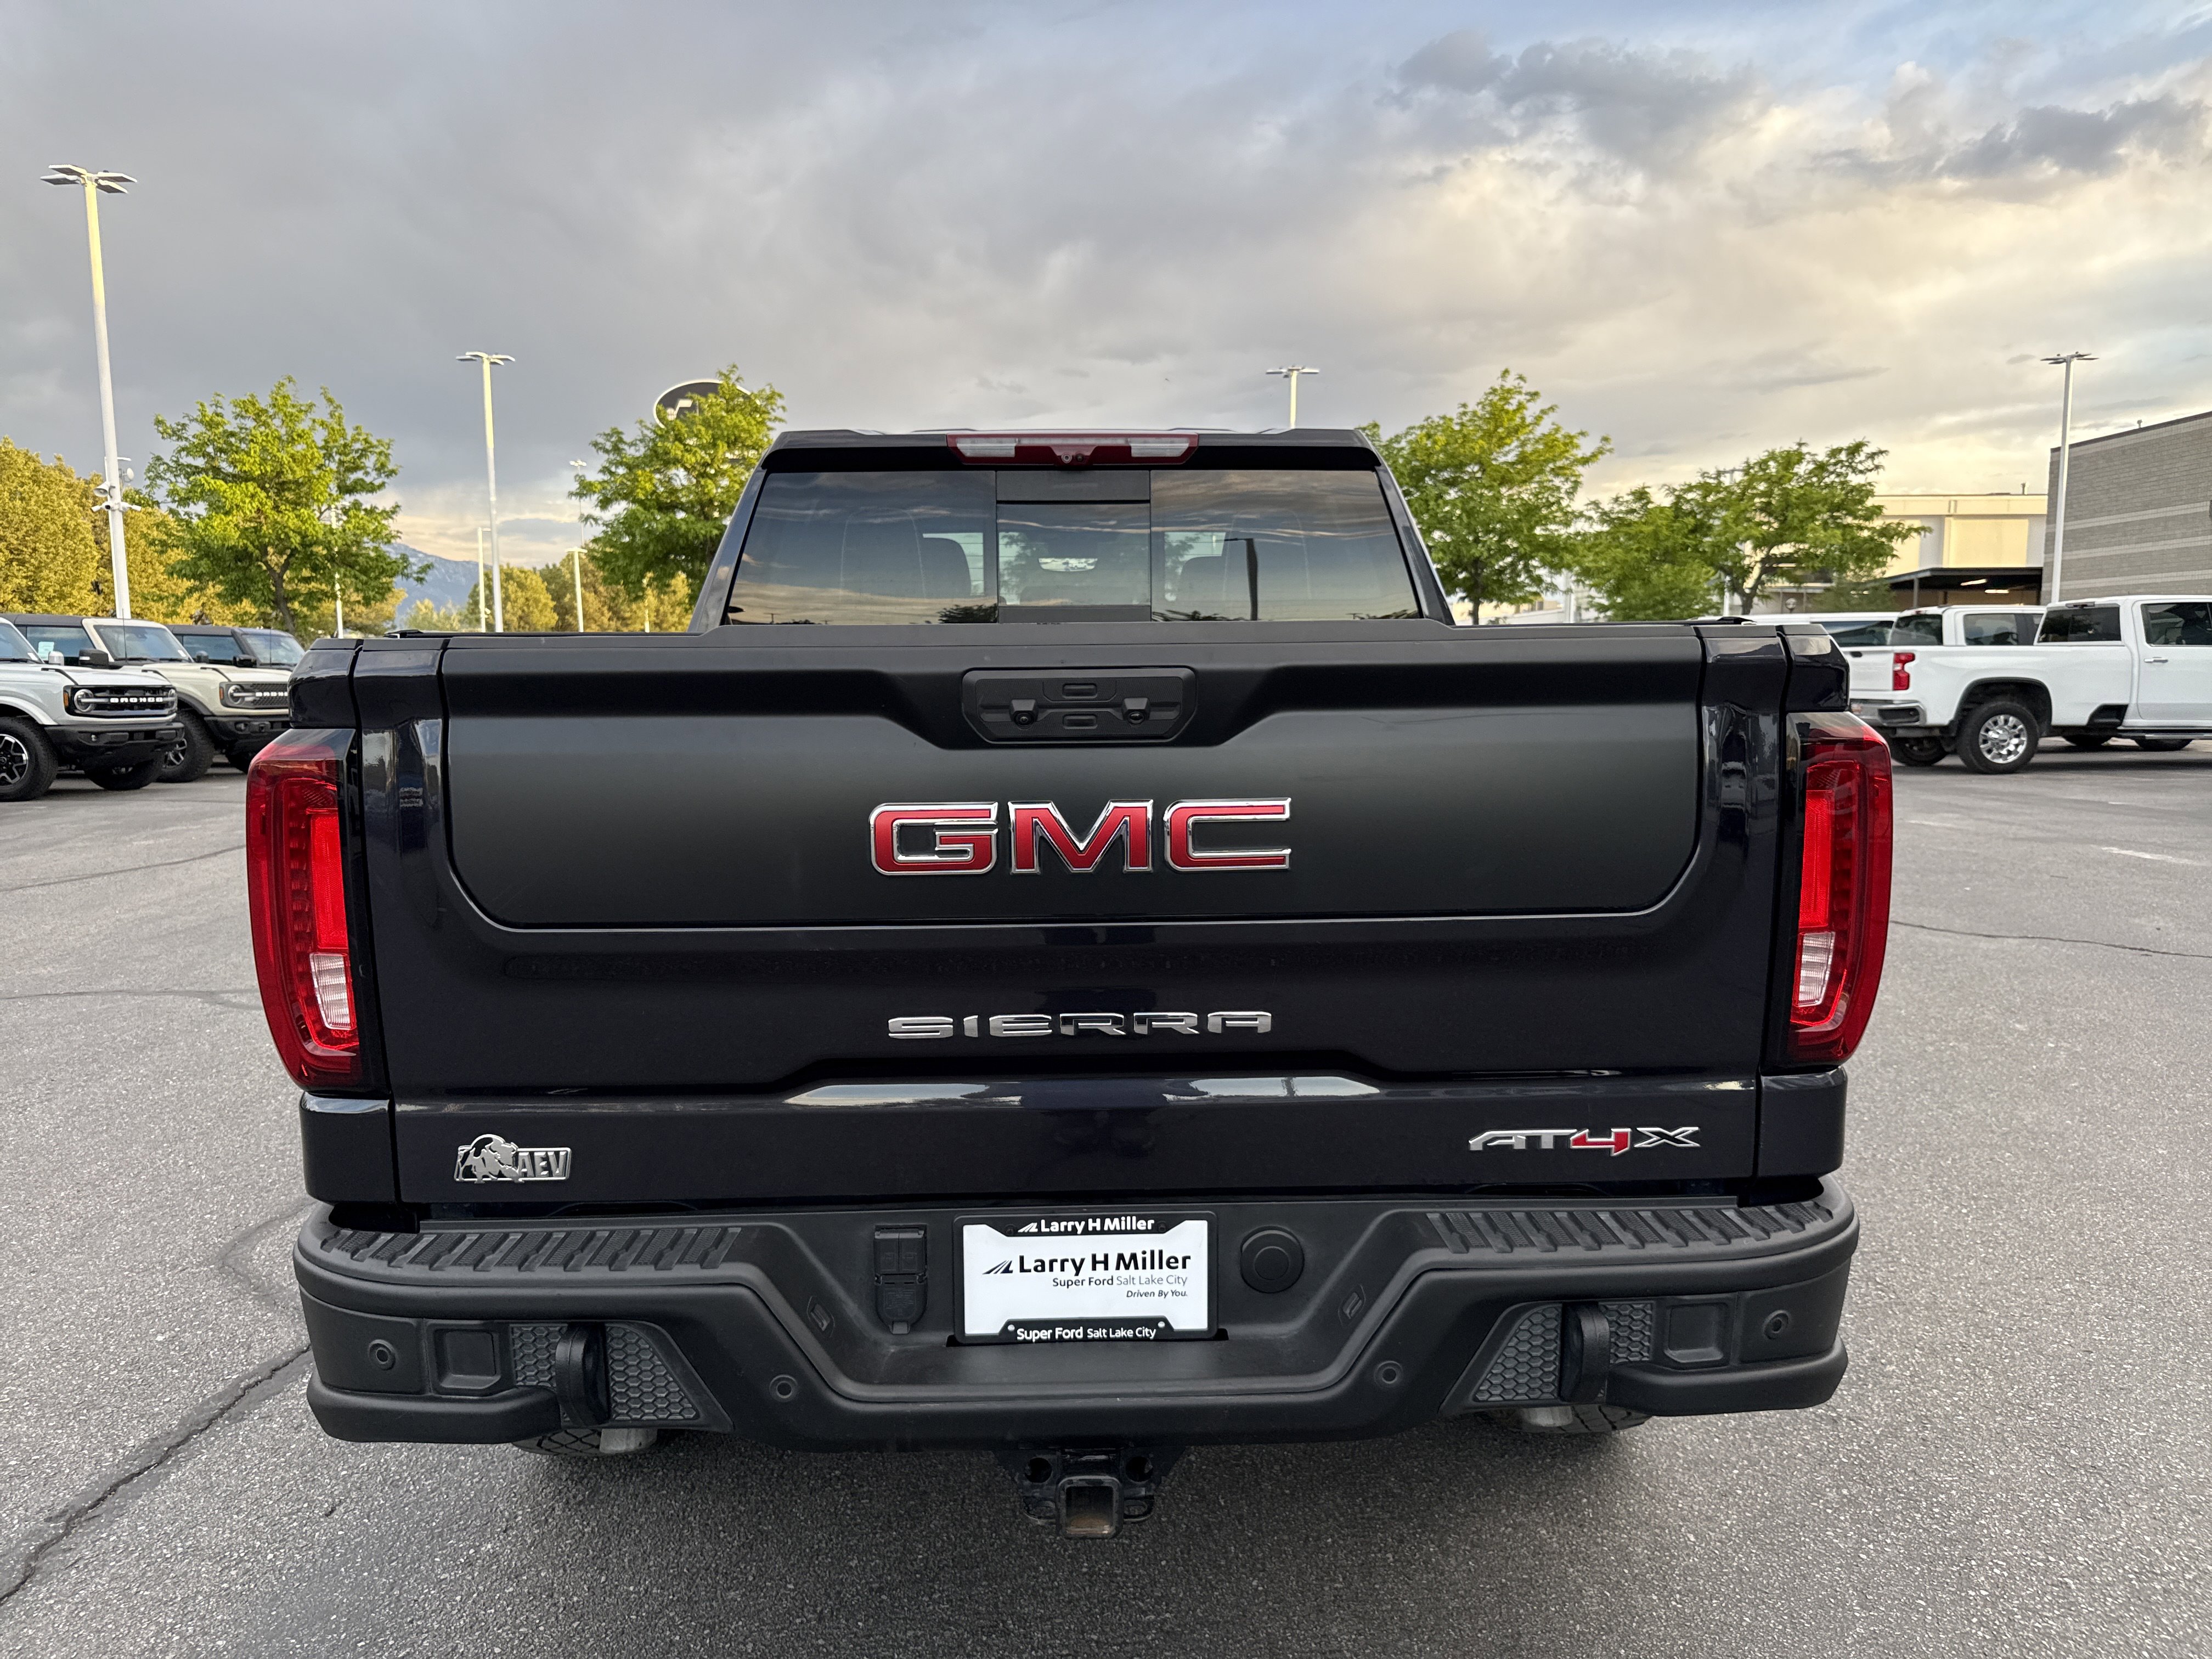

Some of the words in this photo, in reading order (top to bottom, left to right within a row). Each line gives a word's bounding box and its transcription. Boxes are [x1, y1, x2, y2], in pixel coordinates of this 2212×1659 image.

[870, 798, 1291, 876] GMC
[888, 1011, 1272, 1039] SIERRA
[1469, 1127, 1700, 1156] AT4X
[517, 1152, 567, 1178] AEV
[1041, 1219, 1086, 1234] Larry
[1088, 1218, 1101, 1231] H
[1104, 1216, 1155, 1231] Miller
[1019, 1255, 1085, 1277] Larry
[1091, 1252, 1109, 1271] H
[1115, 1249, 1191, 1271] Miller
[1052, 1277, 1086, 1289] Super
[1088, 1275, 1114, 1286] Ford
[1116, 1274, 1136, 1285] Salt
[1139, 1274, 1164, 1285] Lake
[1166, 1274, 1188, 1286] City
[1126, 1290, 1155, 1298] Driven
[1158, 1290, 1169, 1299] By
[1017, 1328, 1053, 1344] Super
[1055, 1327, 1084, 1340] Ford
[1087, 1328, 1107, 1339] Salt
[1109, 1327, 1133, 1338] Lake
[1135, 1326, 1156, 1340] City
